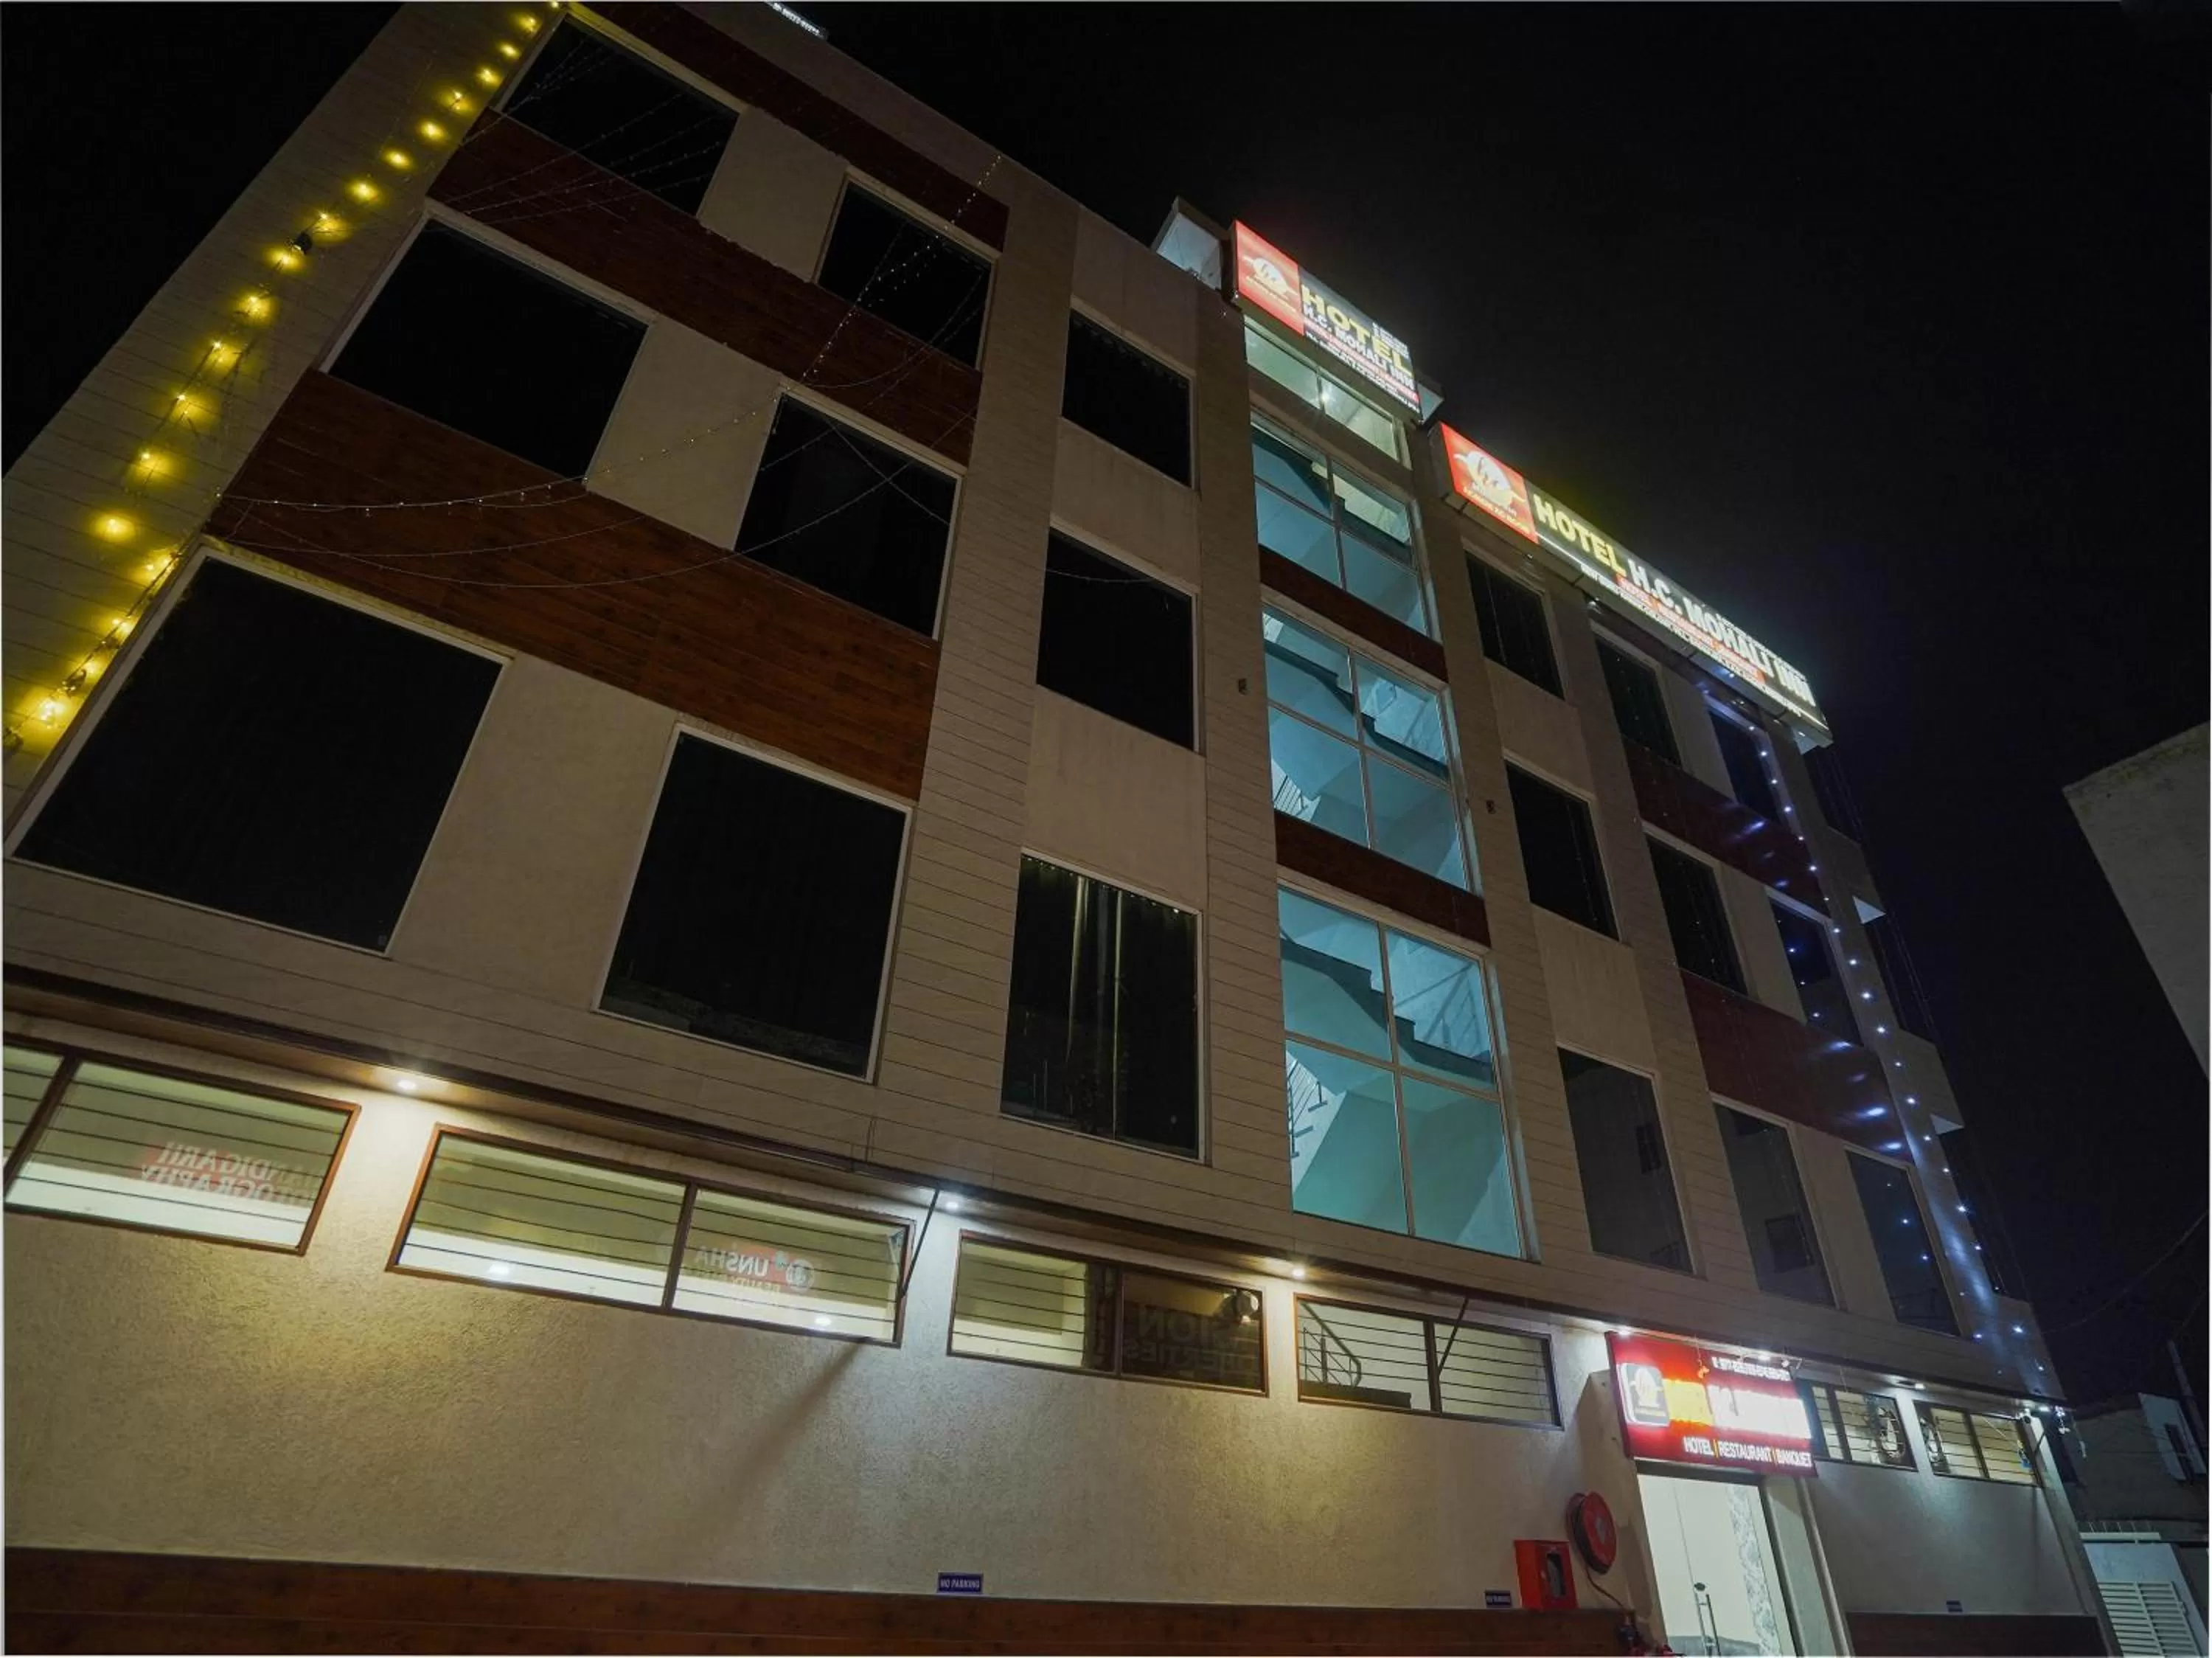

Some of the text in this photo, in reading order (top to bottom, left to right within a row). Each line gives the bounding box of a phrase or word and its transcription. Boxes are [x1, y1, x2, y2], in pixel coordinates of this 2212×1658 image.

[1301, 285, 1413, 378] HOTEL
[1533, 493, 1627, 577] HOTEL
[1628, 558, 1683, 614] H.C.
[1683, 597, 1775, 678] MOHALI
[1773, 658, 1816, 707] INN
[1683, 1436, 1714, 1455] HOTEL
[1718, 1440, 1773, 1463] RESTAURANT
[940, 1578, 980, 1589] NO PARKING
